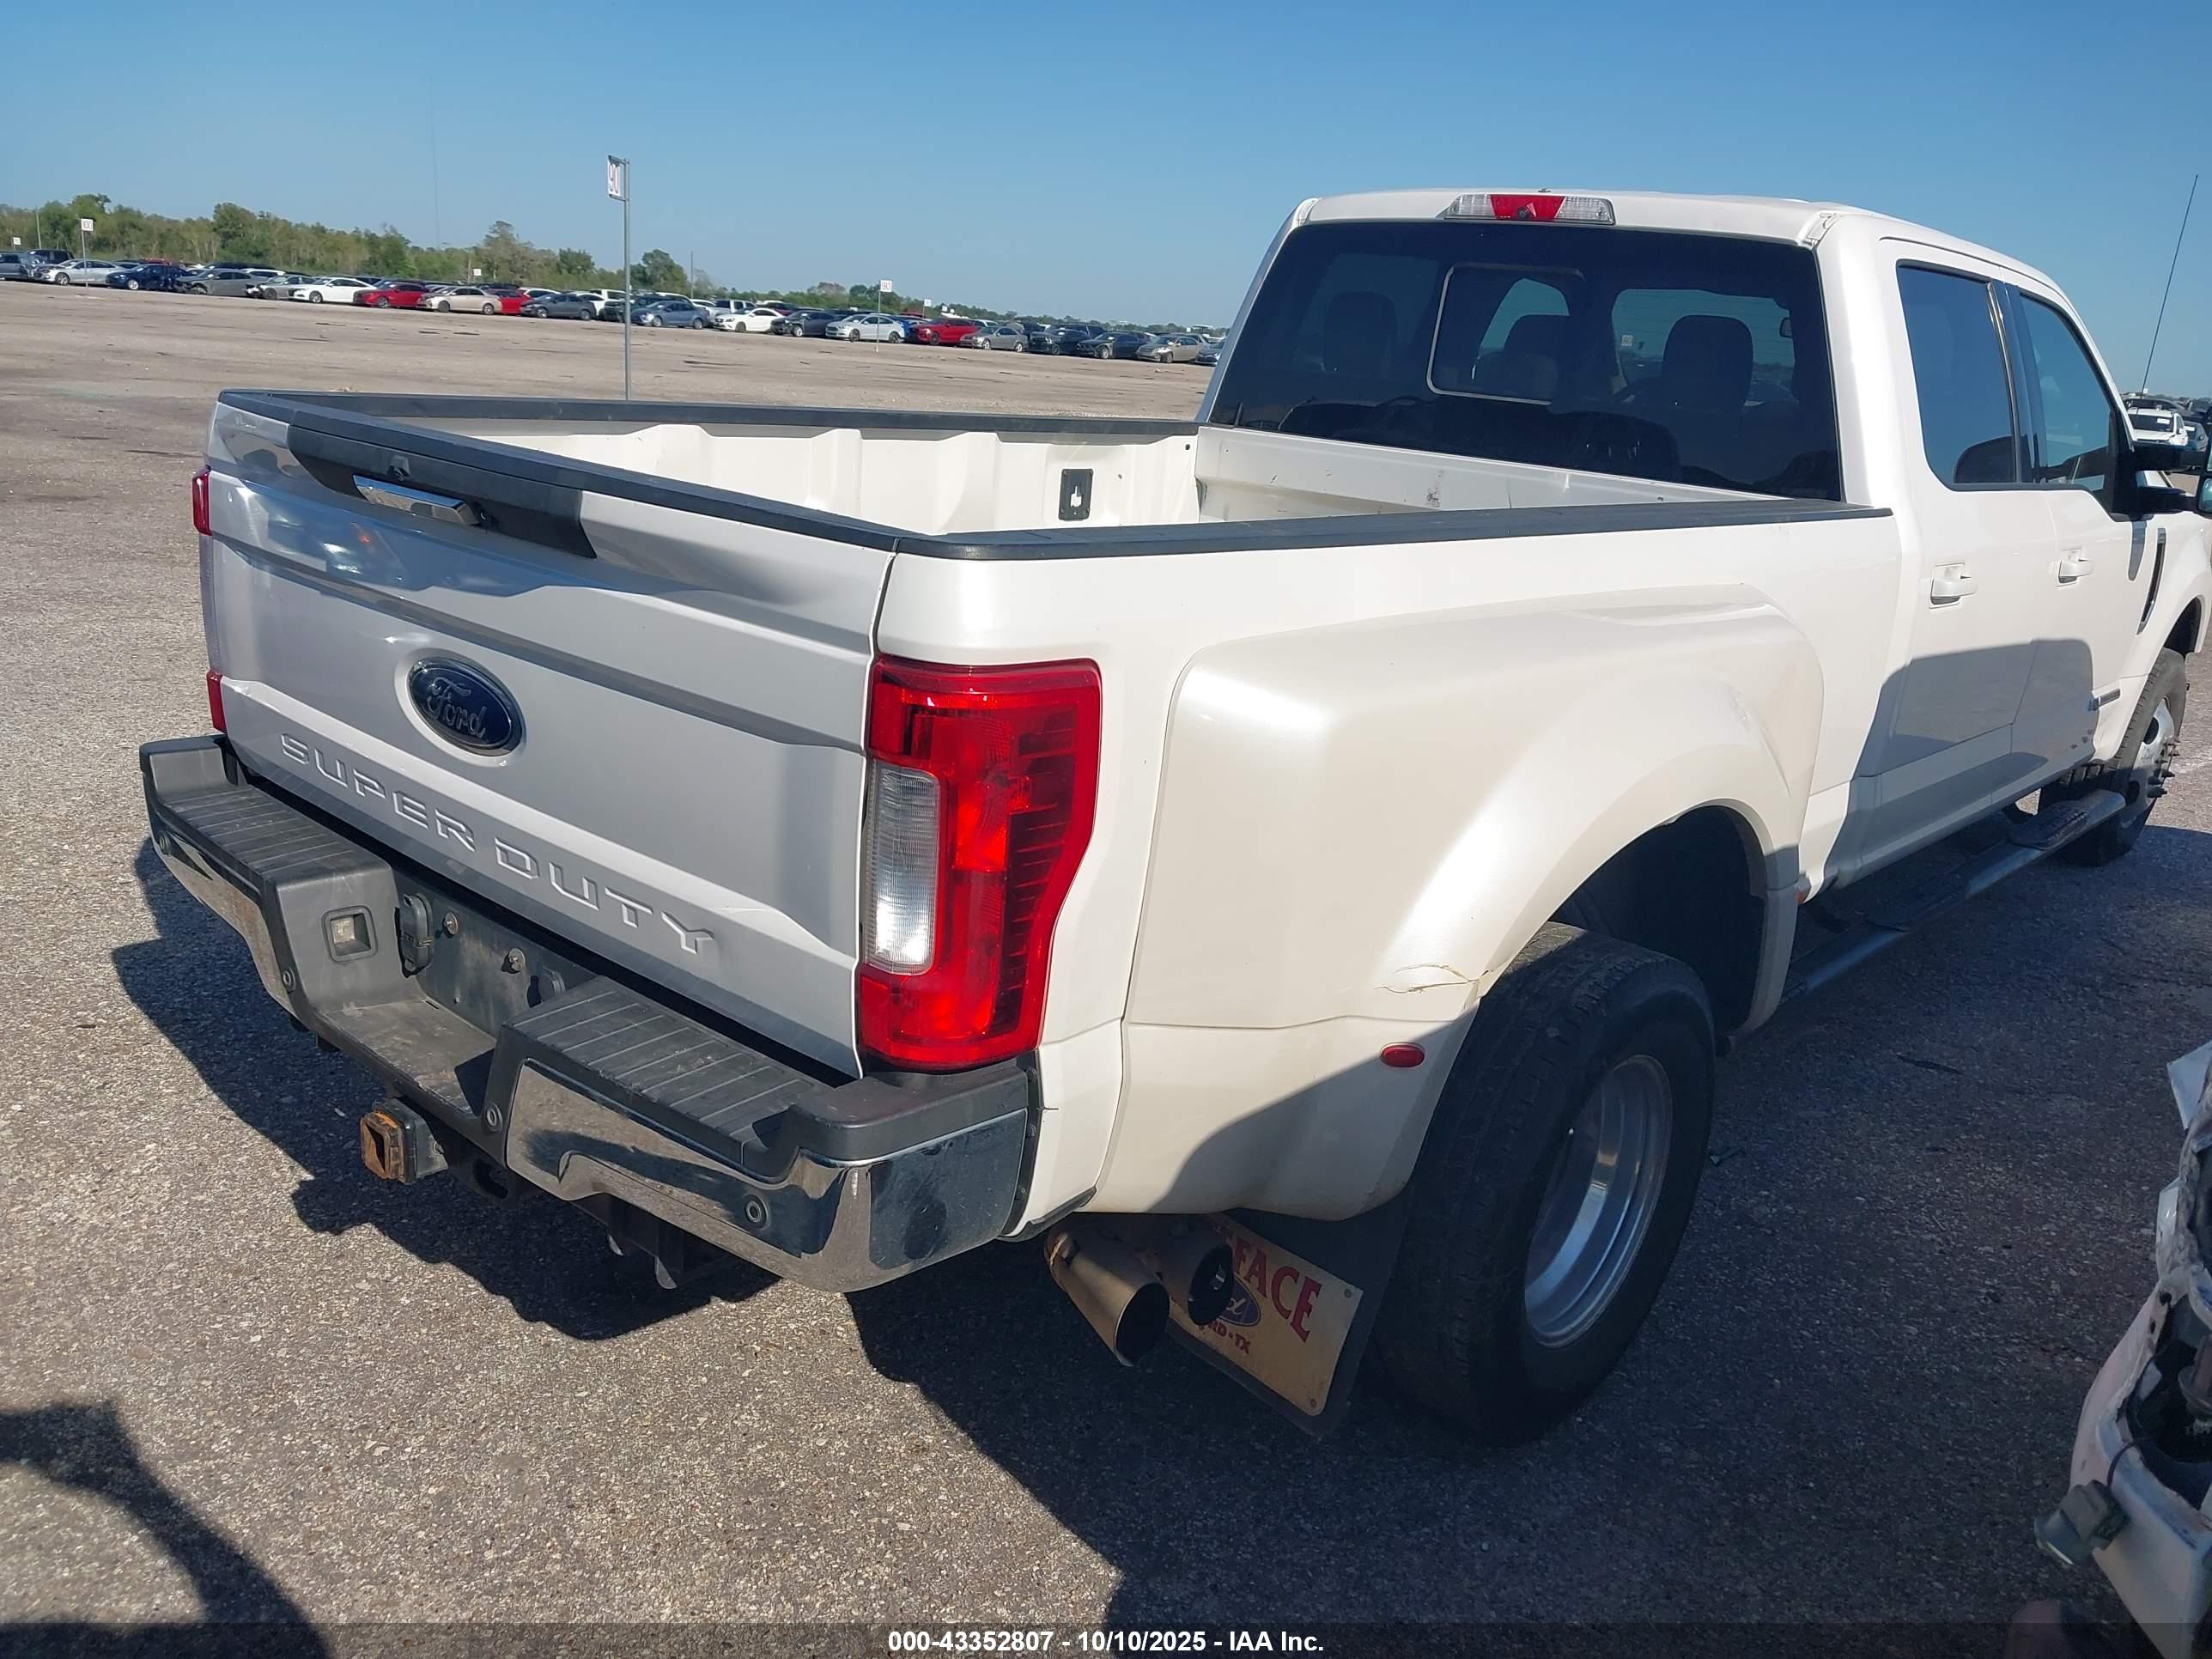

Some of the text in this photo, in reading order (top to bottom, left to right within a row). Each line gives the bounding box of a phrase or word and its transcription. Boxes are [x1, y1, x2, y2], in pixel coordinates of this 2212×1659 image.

[427, 677, 487, 738] Ford
[281, 732, 714, 955] SUPER DUTY
[1232, 1236, 1322, 1344] FACE
